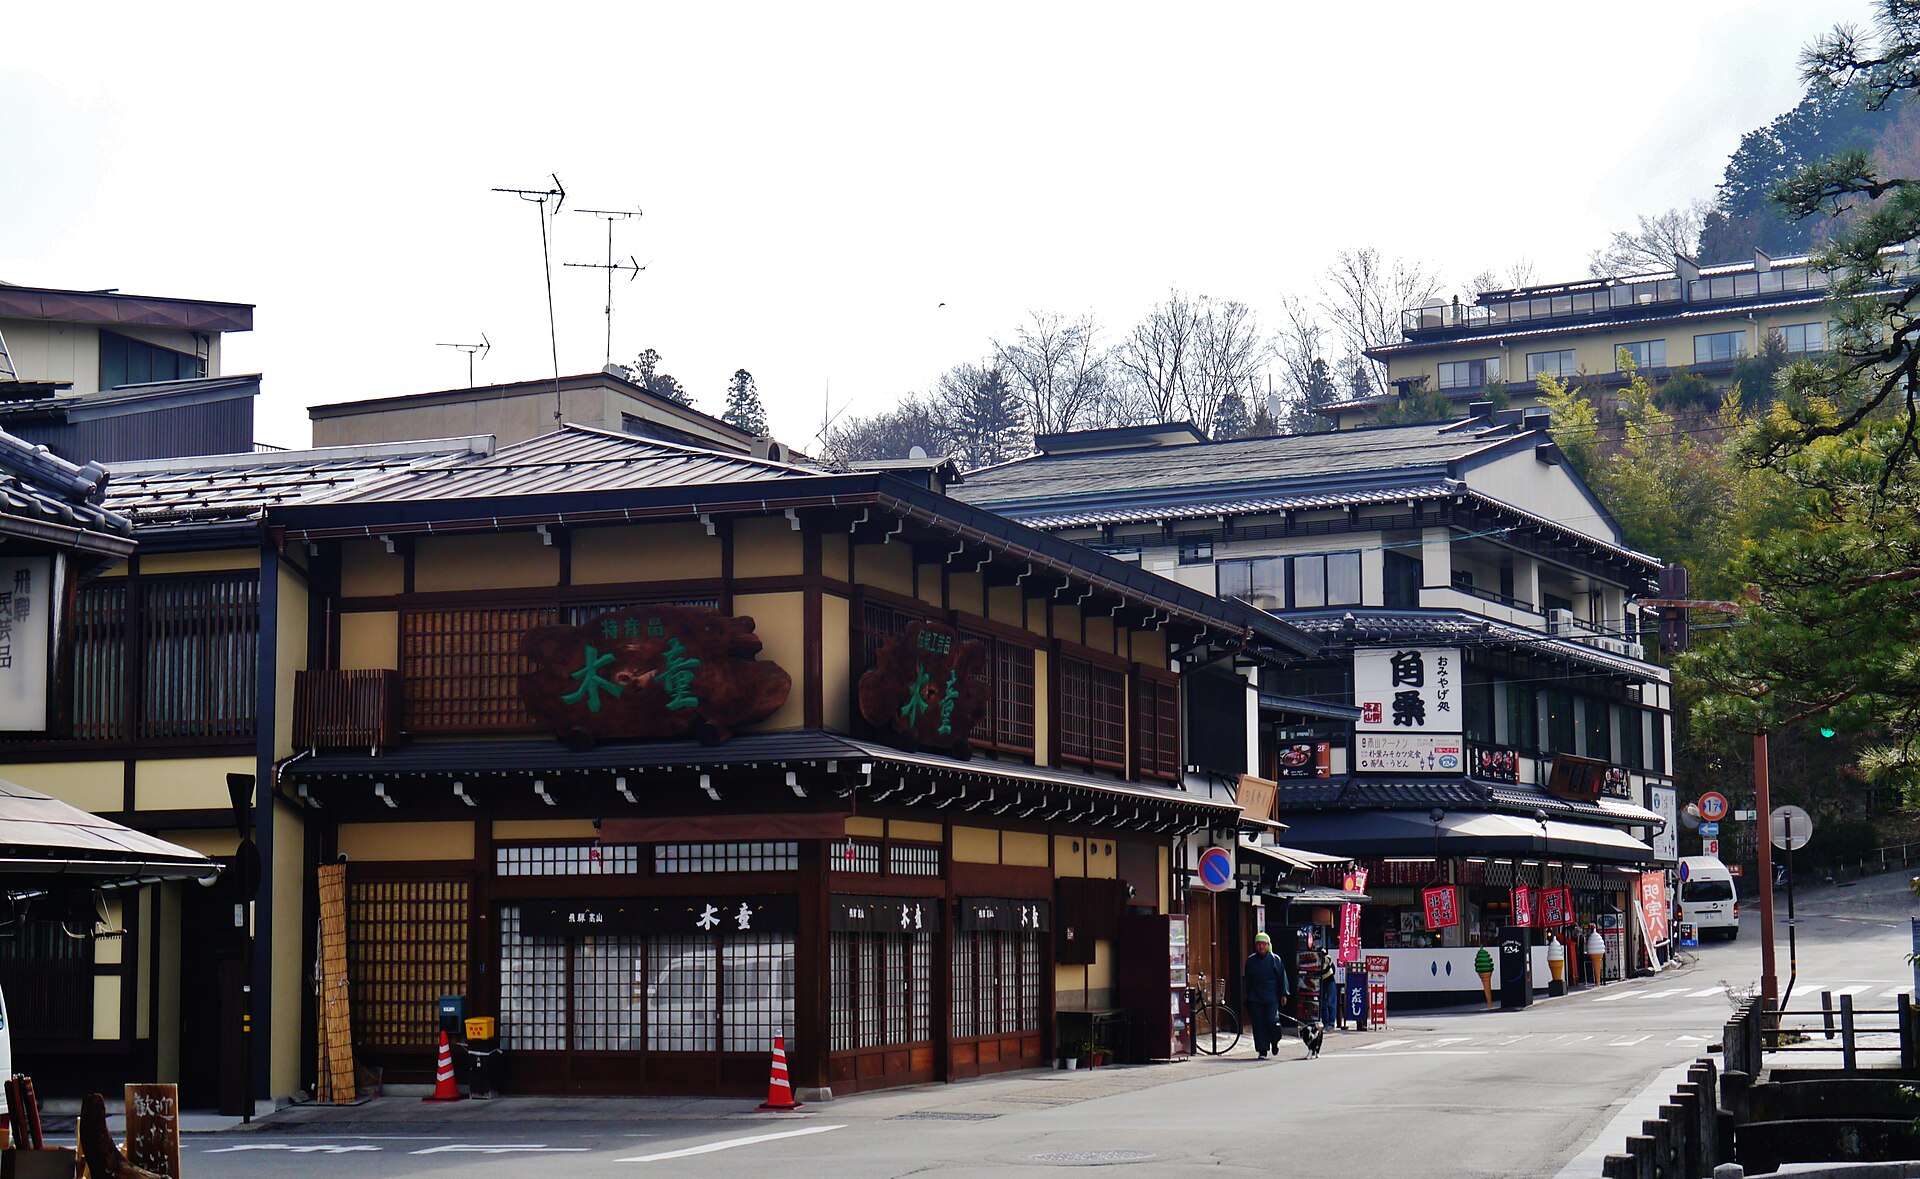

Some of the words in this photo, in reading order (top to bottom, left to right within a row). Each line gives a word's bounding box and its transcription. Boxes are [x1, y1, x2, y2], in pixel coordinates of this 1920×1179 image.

[602, 618, 664, 639] 特産品
[1437, 656, 1450, 712] おみやげ処
[1546, 894, 1561, 922] 甘酒
[133, 1092, 174, 1120] 歓迎
